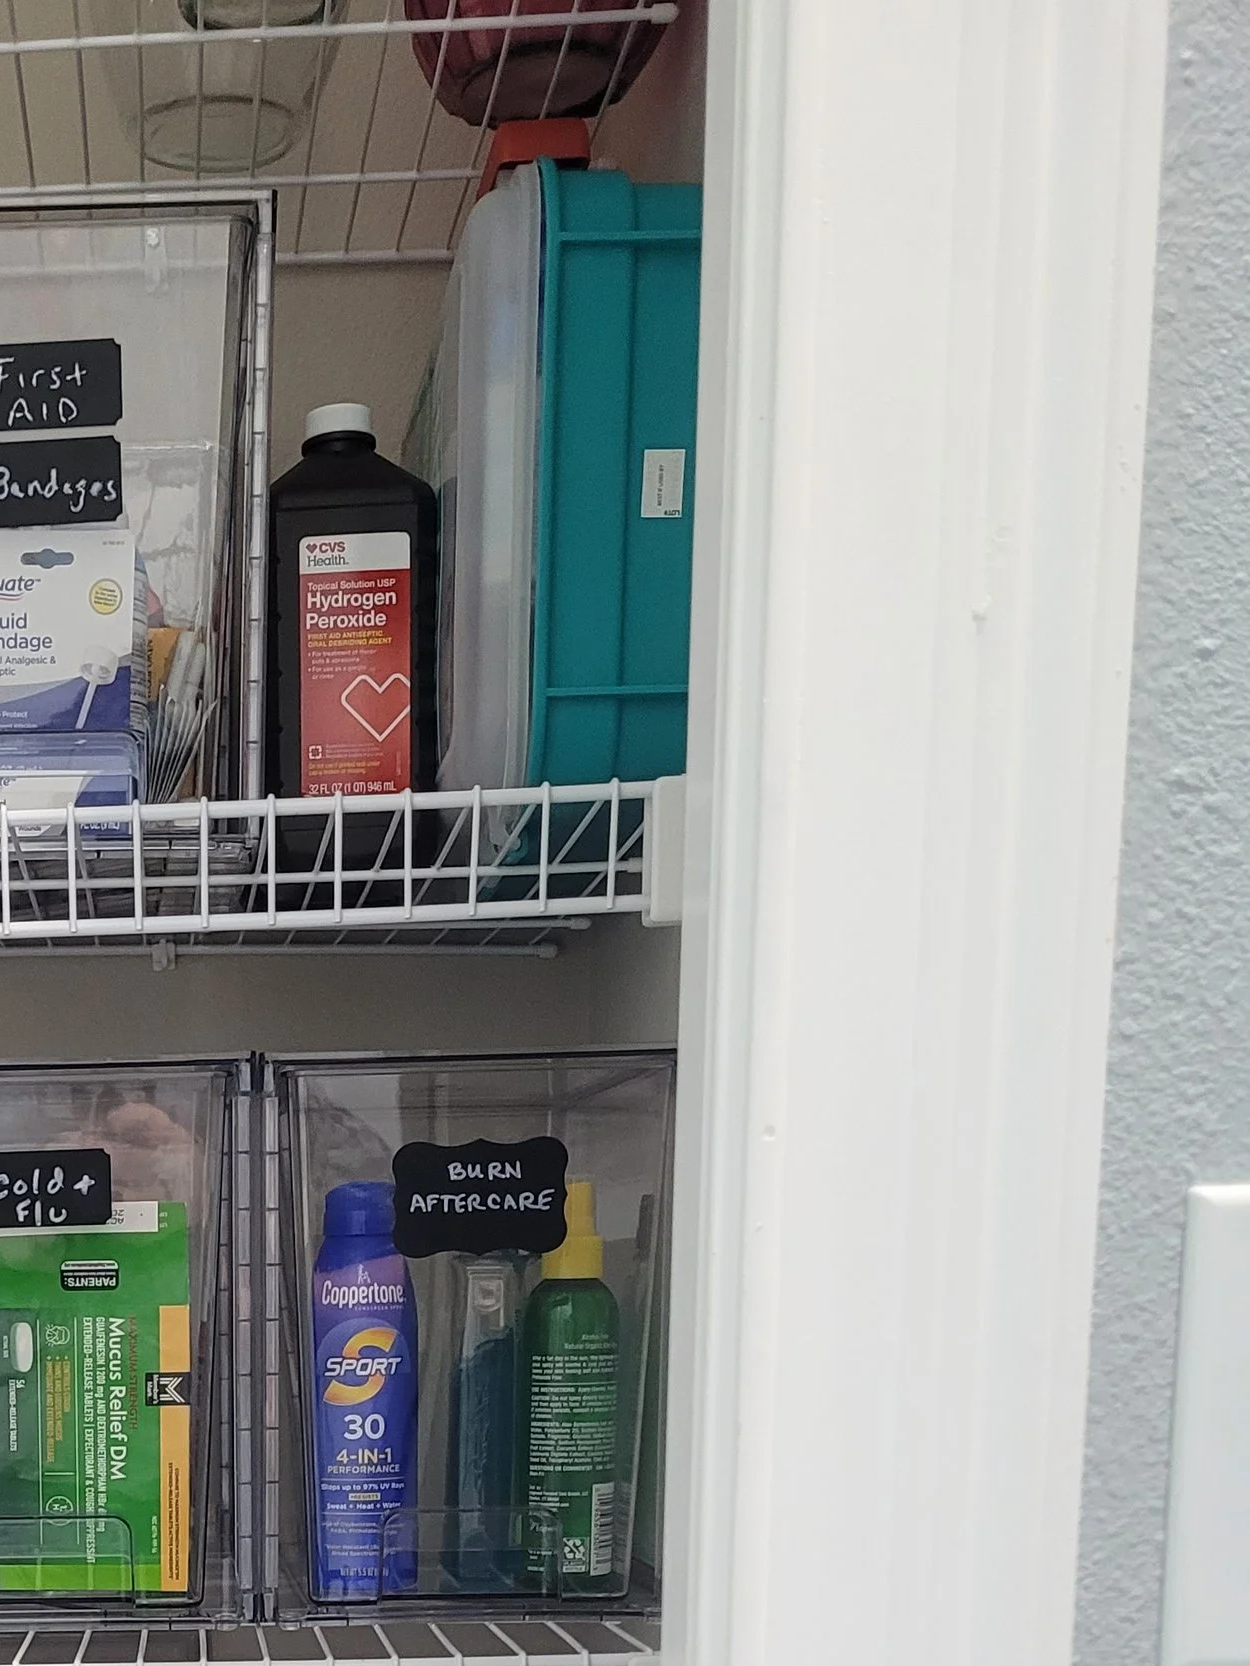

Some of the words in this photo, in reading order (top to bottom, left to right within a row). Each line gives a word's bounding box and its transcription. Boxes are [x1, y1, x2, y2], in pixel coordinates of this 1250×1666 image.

[8, 398, 77, 427] AID
[318, 541, 346, 553] CVS
[307, 582, 339, 592] Topical
[340, 580, 375, 591] Solution
[377, 579, 396, 588] USP
[307, 591, 397, 612] Hydrogen
[306, 610, 387, 630] Peroxide
[308, 639, 327, 648] ORAL
[368, 637, 393, 646] AGENT
[4, 655, 48, 666] Analgesic
[49, 656, 56, 664] &
[309, 783, 320, 794] 32
[320, 783, 329, 794] FL
[367, 781, 383, 792] 946
[383, 780, 397, 791] mL
[447, 1160, 522, 1181] BURN
[73, 1174, 96, 1196] +
[409, 1188, 555, 1214] AFTERCARE
[15, 1198, 68, 1227] Flu
[64, 1276, 117, 1288] PARENTS:
[95, 1317, 106, 1366] GUAIFENESIN
[108, 1317, 126, 1380] Mucus
[83, 1317, 94, 1390] EXTENDED-RELEASE
[95, 1367, 105, 1384] 1200
[324, 1357, 402, 1377] SPORT
[84, 1392, 94, 1422] TABLETS
[96, 1400, 106, 1414] AND
[109, 1386, 128, 1441] Relief
[343, 1413, 386, 1440] 30
[85, 1428, 96, 1478] EXPECTORANT
[96, 1416, 107, 1492] DEXTROMETHORPHAN
[110, 1446, 127, 1480] DM
[336, 1447, 392, 1465] 4-IN-1
[327, 1463, 400, 1475] PERFORMANCE
[352, 1483, 360, 1491] to
[85, 1487, 96, 1512] COUGH
